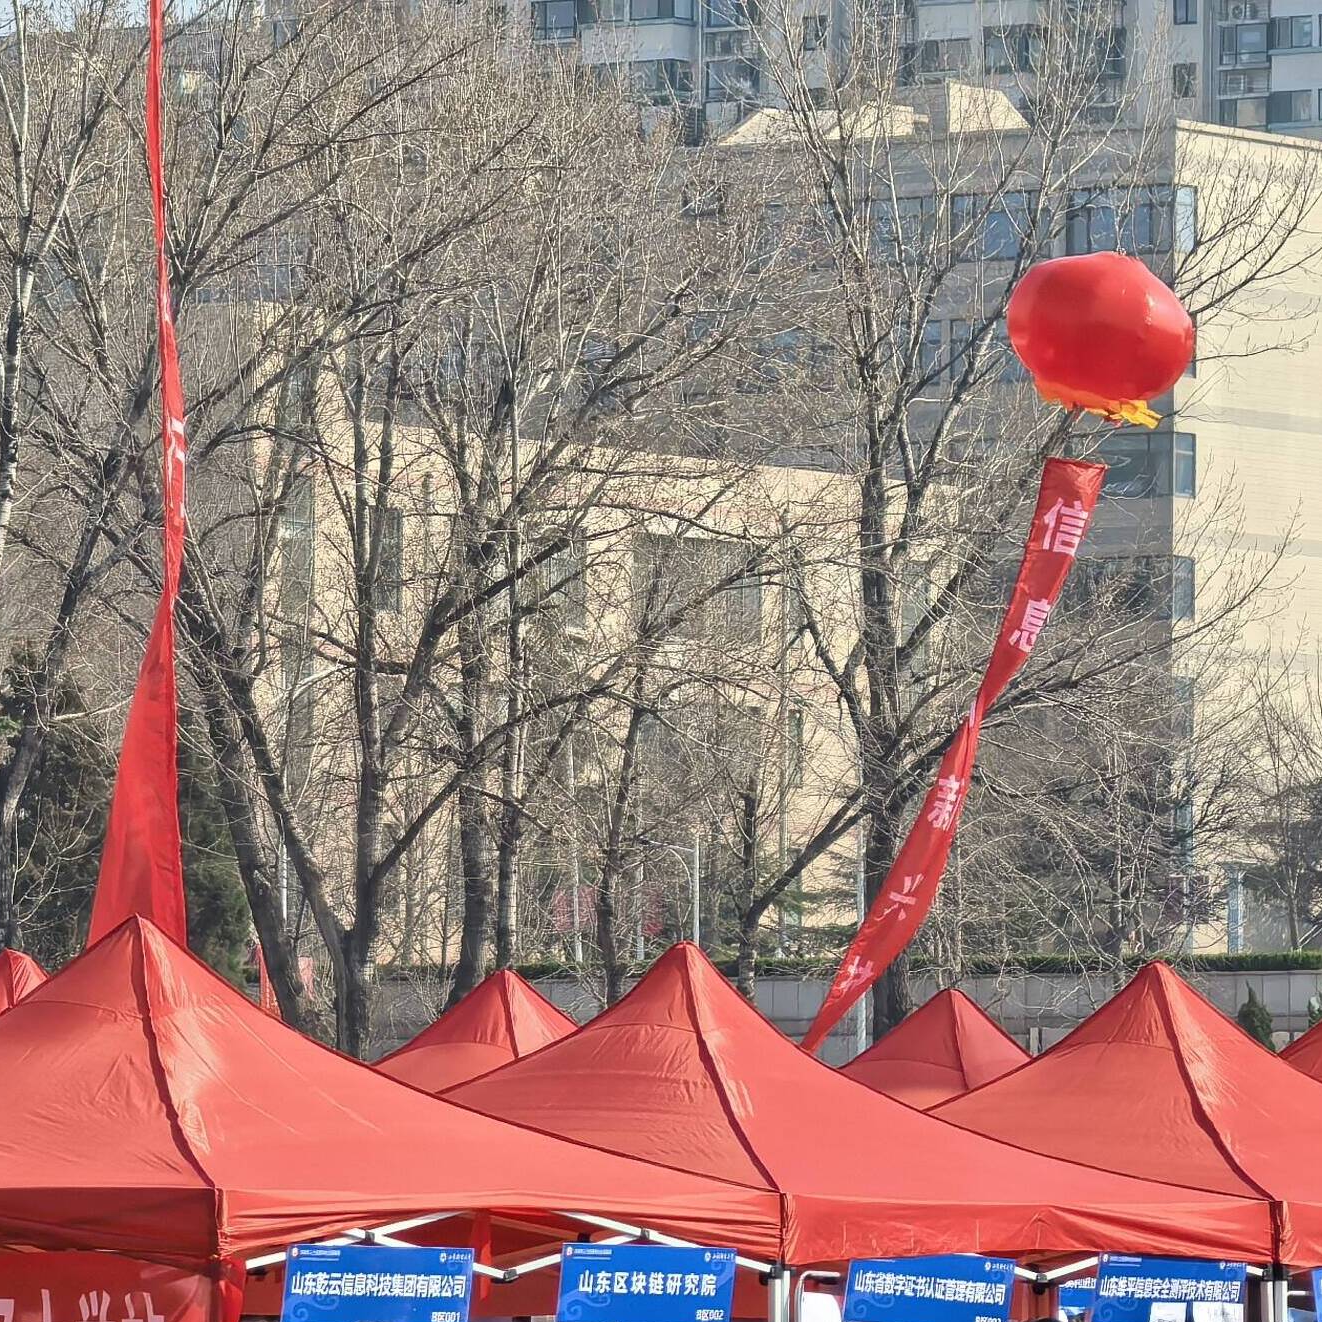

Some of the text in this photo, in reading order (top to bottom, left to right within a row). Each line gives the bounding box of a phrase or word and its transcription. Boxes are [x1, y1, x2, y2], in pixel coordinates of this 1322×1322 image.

[291, 1271, 467, 1299] 山东乾云信息科技集团有限公司
[578, 1269, 718, 1297] 山东区块链研究院
[854, 1269, 1007, 1306] 山东省数字证书认证管理有限公司
[1098, 1275, 1242, 1302] 山东维平信息安全测评技术有限公司
[695, 1309, 724, 1322] B区002
